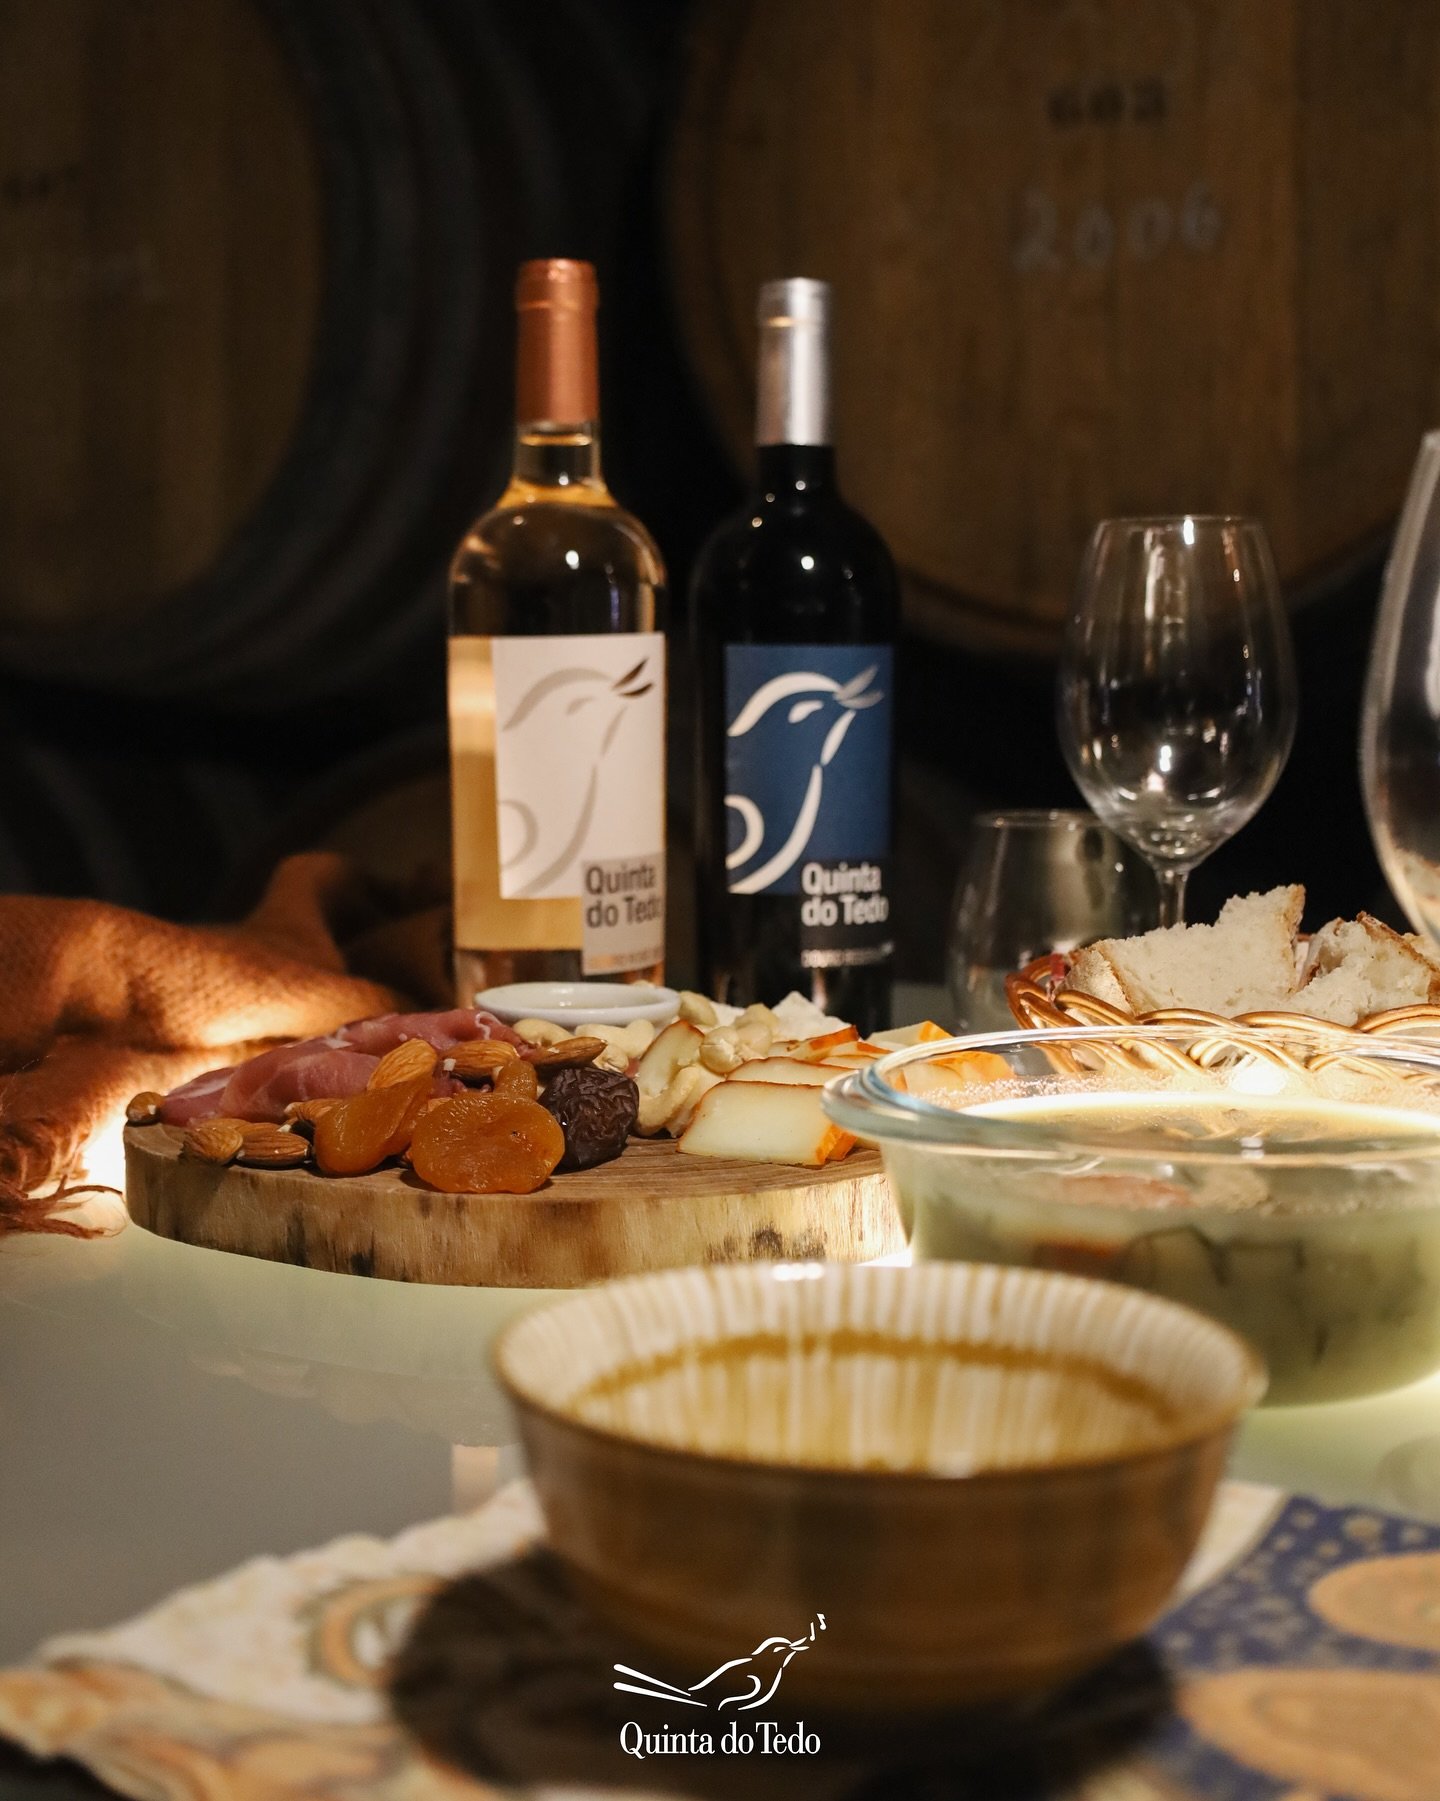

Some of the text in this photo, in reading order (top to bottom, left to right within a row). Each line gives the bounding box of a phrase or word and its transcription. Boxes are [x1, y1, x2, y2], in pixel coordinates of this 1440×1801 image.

[1014, 180, 1220, 271] 2006
[585, 862, 656, 895] Quinta
[801, 861, 881, 896] Quinta
[586, 900, 619, 928] do
[801, 893, 889, 926] do Tedo
